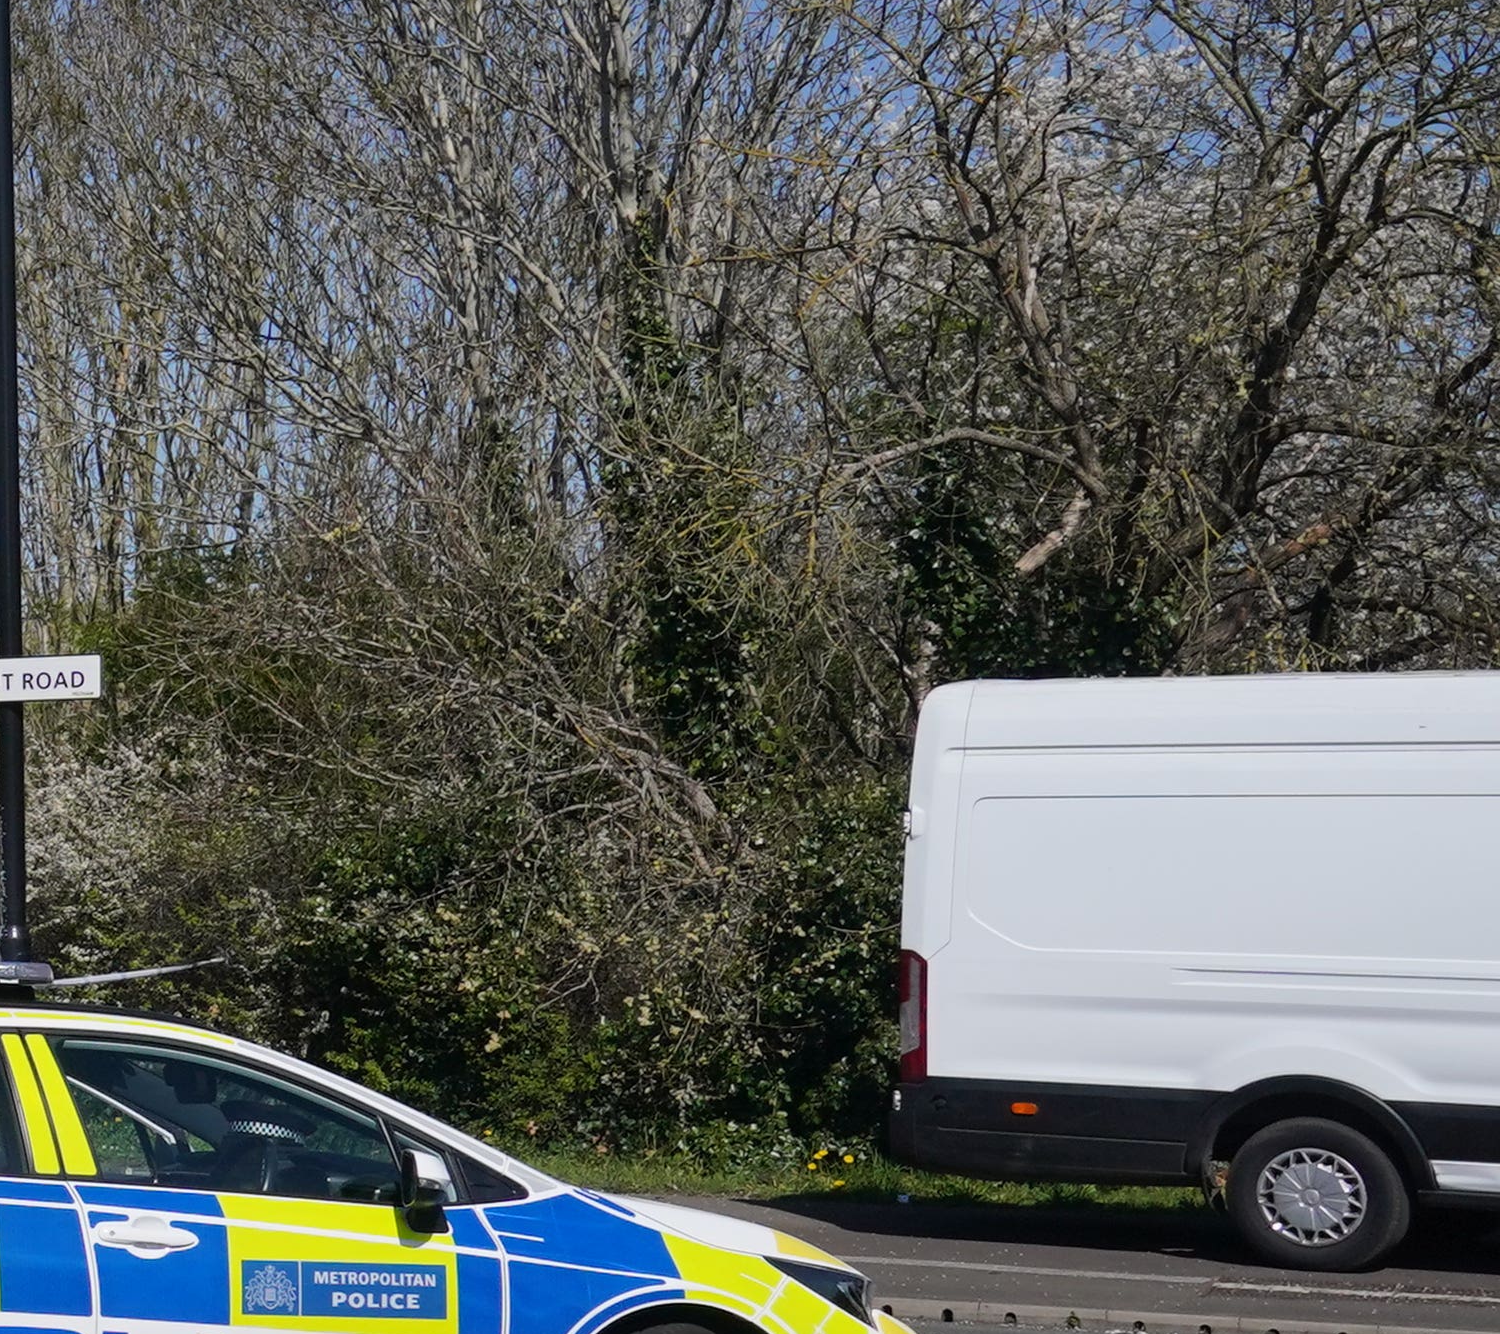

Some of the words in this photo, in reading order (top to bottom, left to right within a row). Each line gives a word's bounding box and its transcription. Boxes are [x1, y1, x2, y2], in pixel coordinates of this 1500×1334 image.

[21, 670, 86, 691] ROAD
[313, 1270, 437, 1288] METROPOLITAN
[331, 1291, 421, 1310] POLICE
